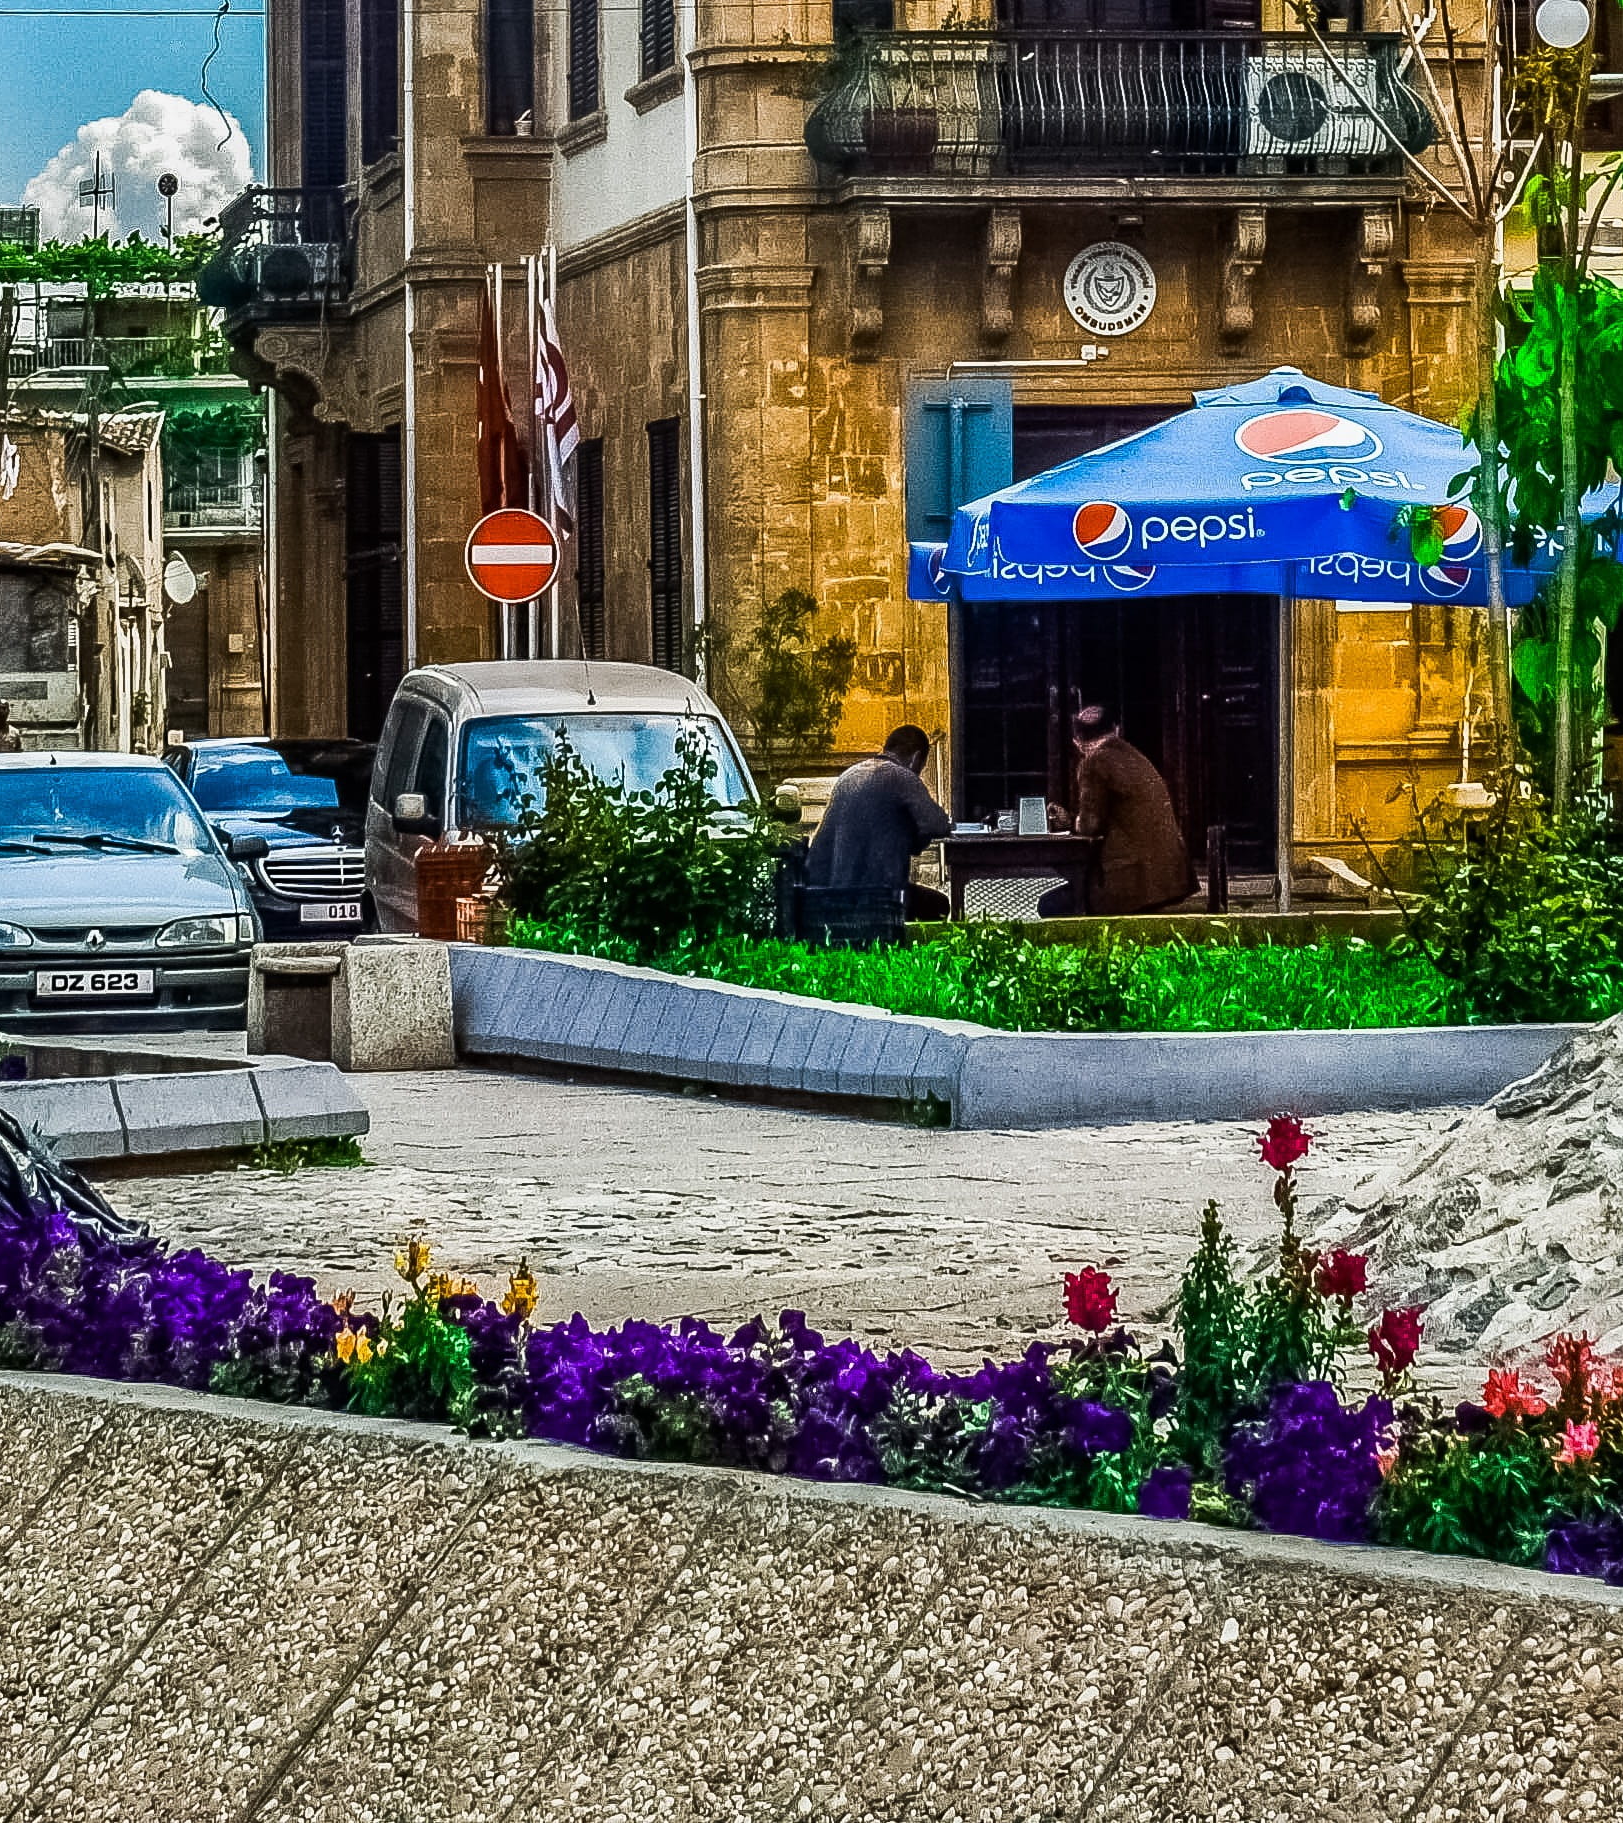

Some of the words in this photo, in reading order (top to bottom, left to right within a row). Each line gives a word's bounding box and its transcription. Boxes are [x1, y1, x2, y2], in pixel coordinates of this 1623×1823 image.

[1075, 304, 1147, 331] OMBUDSMAN
[1241, 466, 1411, 491] pepsi
[1142, 506, 1255, 550] pepsi
[328, 904, 358, 919] 018
[51, 974, 85, 992] DZ
[90, 973, 139, 992] 623
